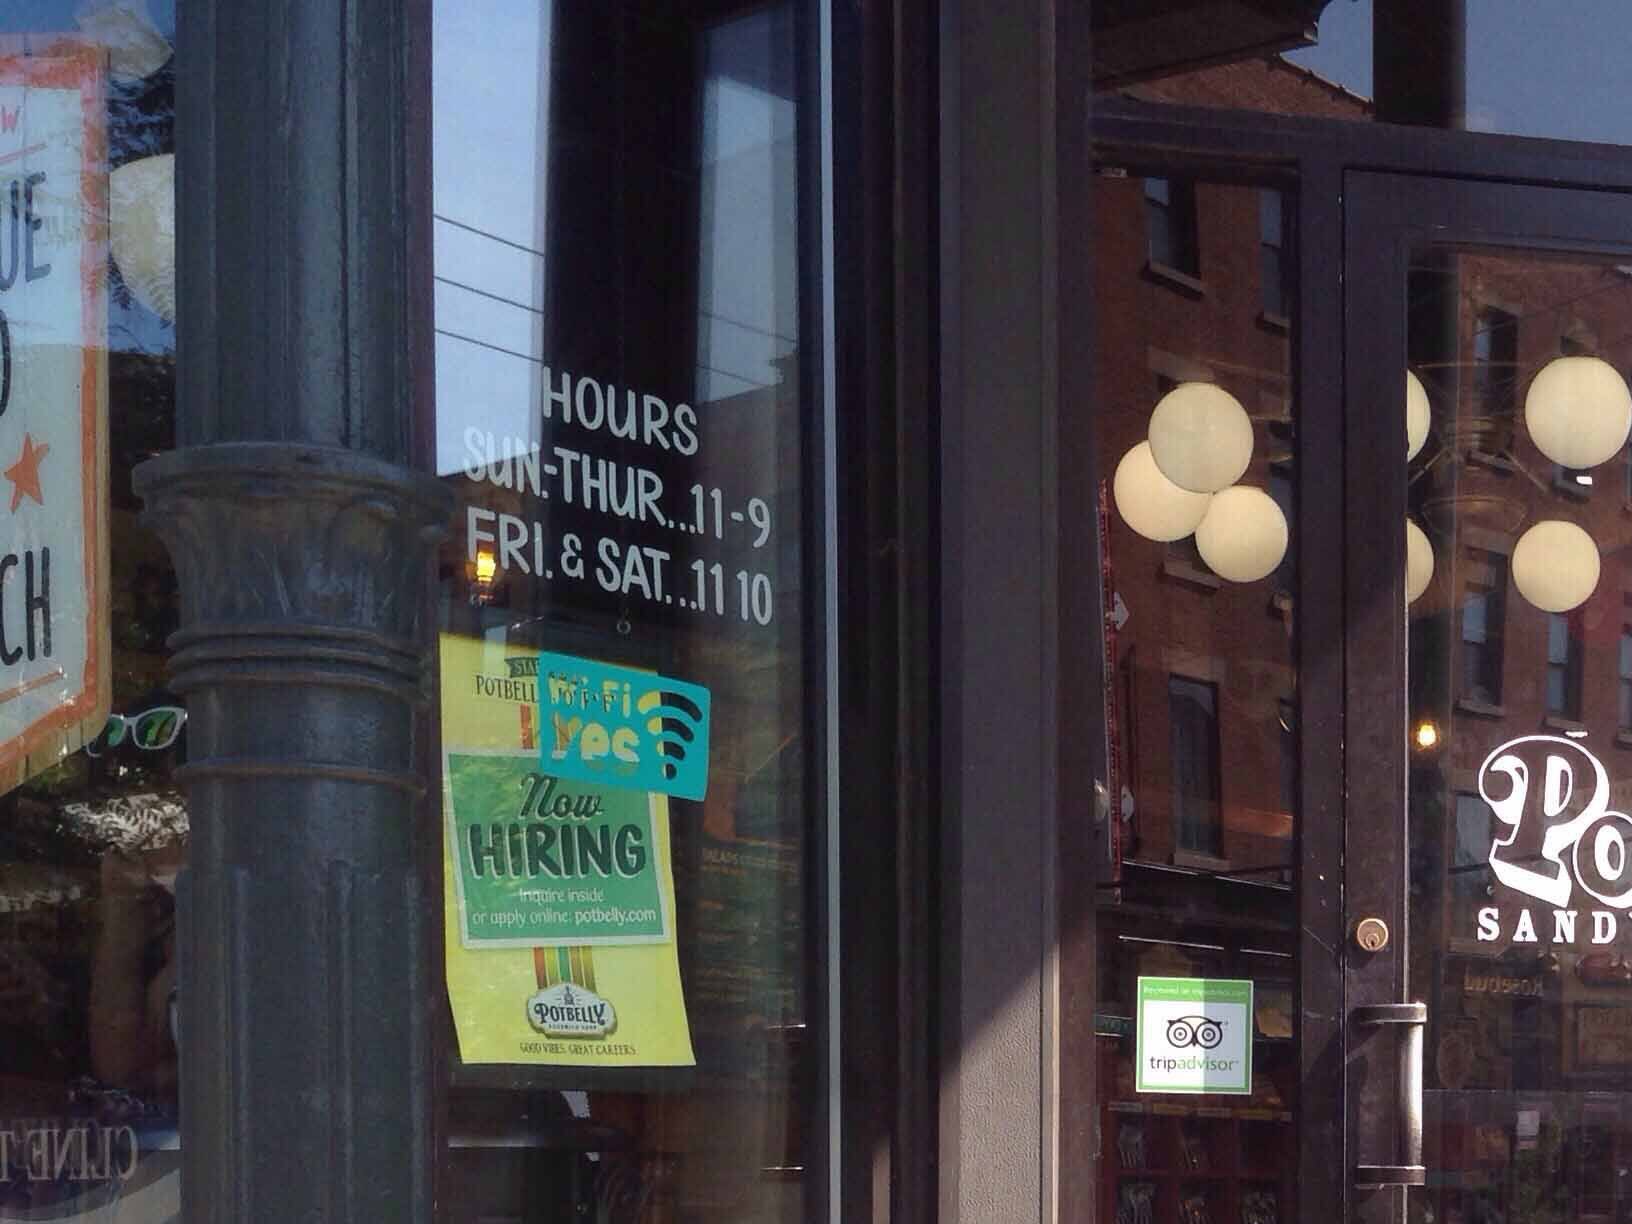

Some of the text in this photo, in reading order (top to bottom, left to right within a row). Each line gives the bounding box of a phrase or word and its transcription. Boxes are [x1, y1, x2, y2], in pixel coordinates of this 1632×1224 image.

[543, 366, 699, 456] HOURS
[561, 533, 584, 579] &
[476, 675, 538, 703] POTBELL
[520, 772, 603, 820] Now
[468, 823, 647, 879] HIRING
[568, 887, 605, 902] inside
[473, 913, 487, 926] or
[490, 908, 526, 928] apply
[574, 907, 657, 927] potbelly.com
[534, 1002, 606, 1025] POTBELLY
[1149, 1056, 1236, 1072] tripadvisor
